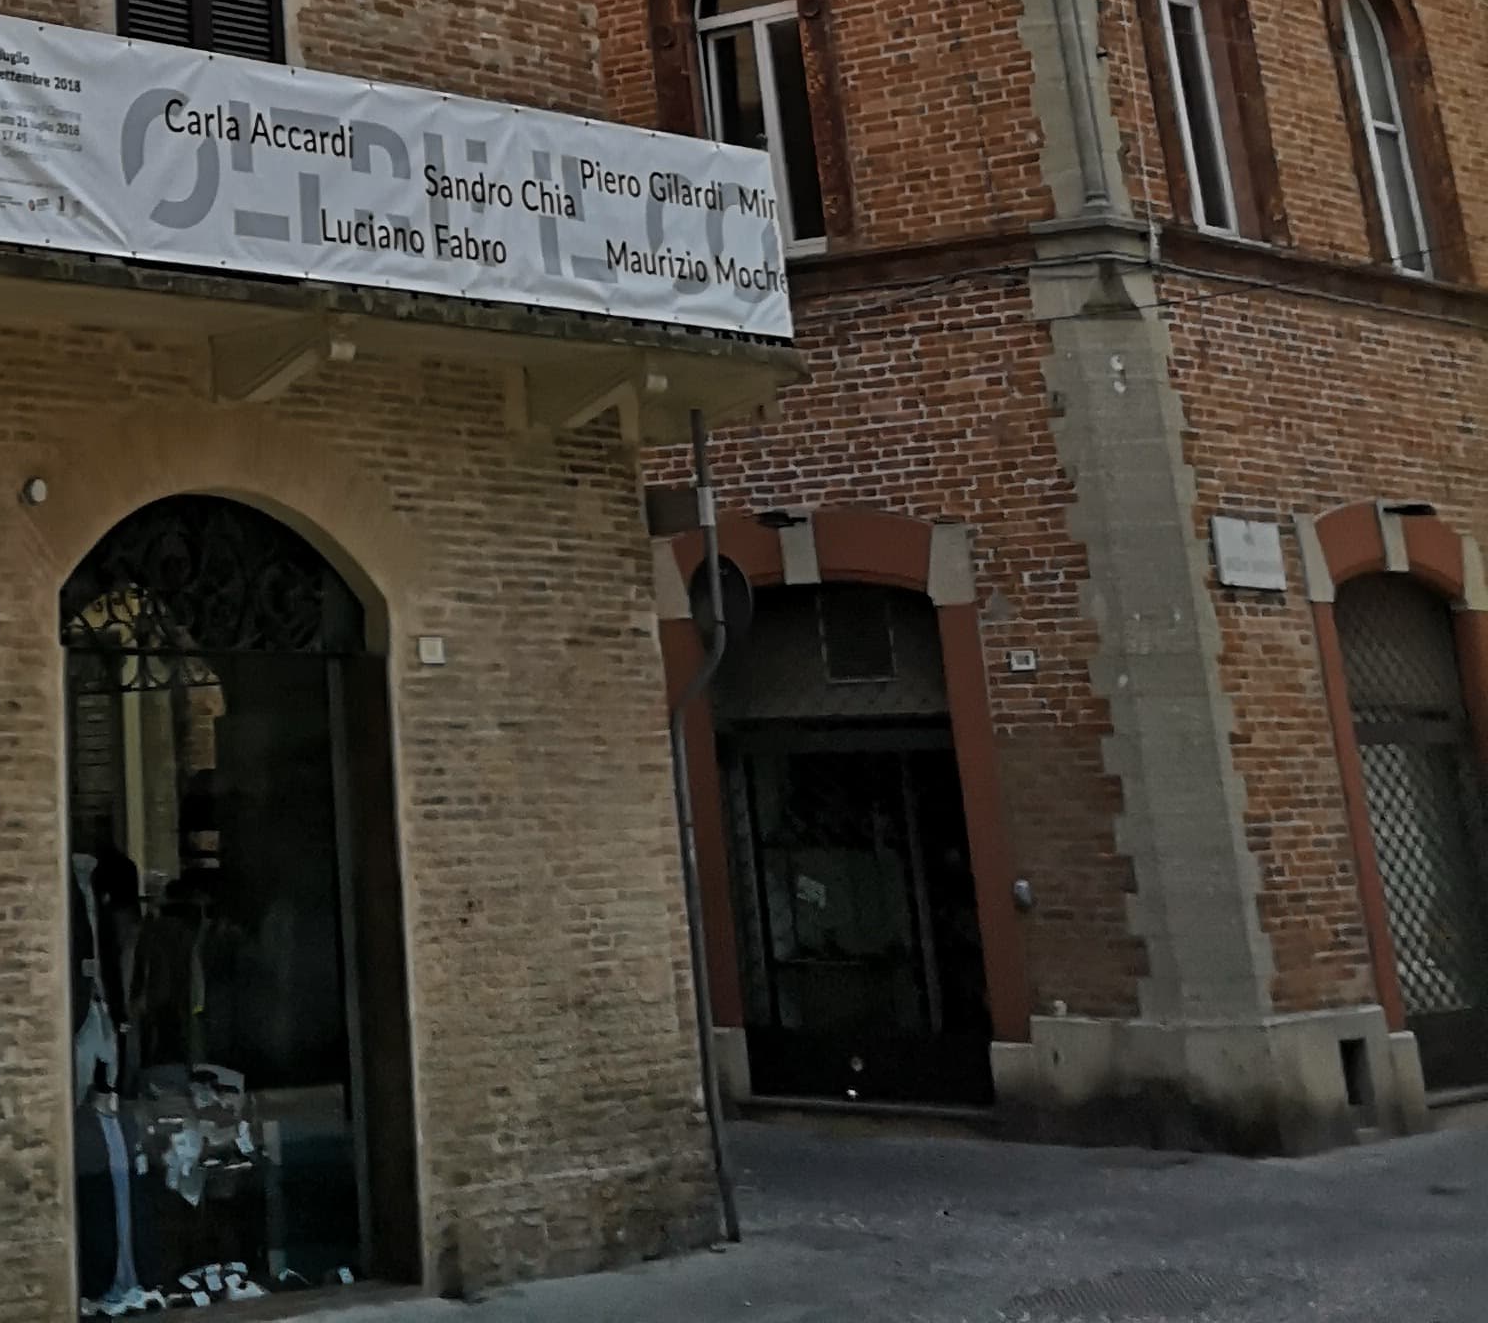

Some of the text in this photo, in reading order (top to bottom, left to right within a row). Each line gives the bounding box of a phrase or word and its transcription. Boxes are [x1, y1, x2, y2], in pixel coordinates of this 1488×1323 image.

[54, 76, 81, 93] 2018
[164, 98, 355, 160] Carla Accardi
[423, 163, 577, 218] Sandro Chia
[579, 159, 641, 198] Piero
[648, 171, 724, 212] Gilardi
[320, 207, 507, 264] Luciano Fabro
[605, 238, 709, 284] Maurizio
